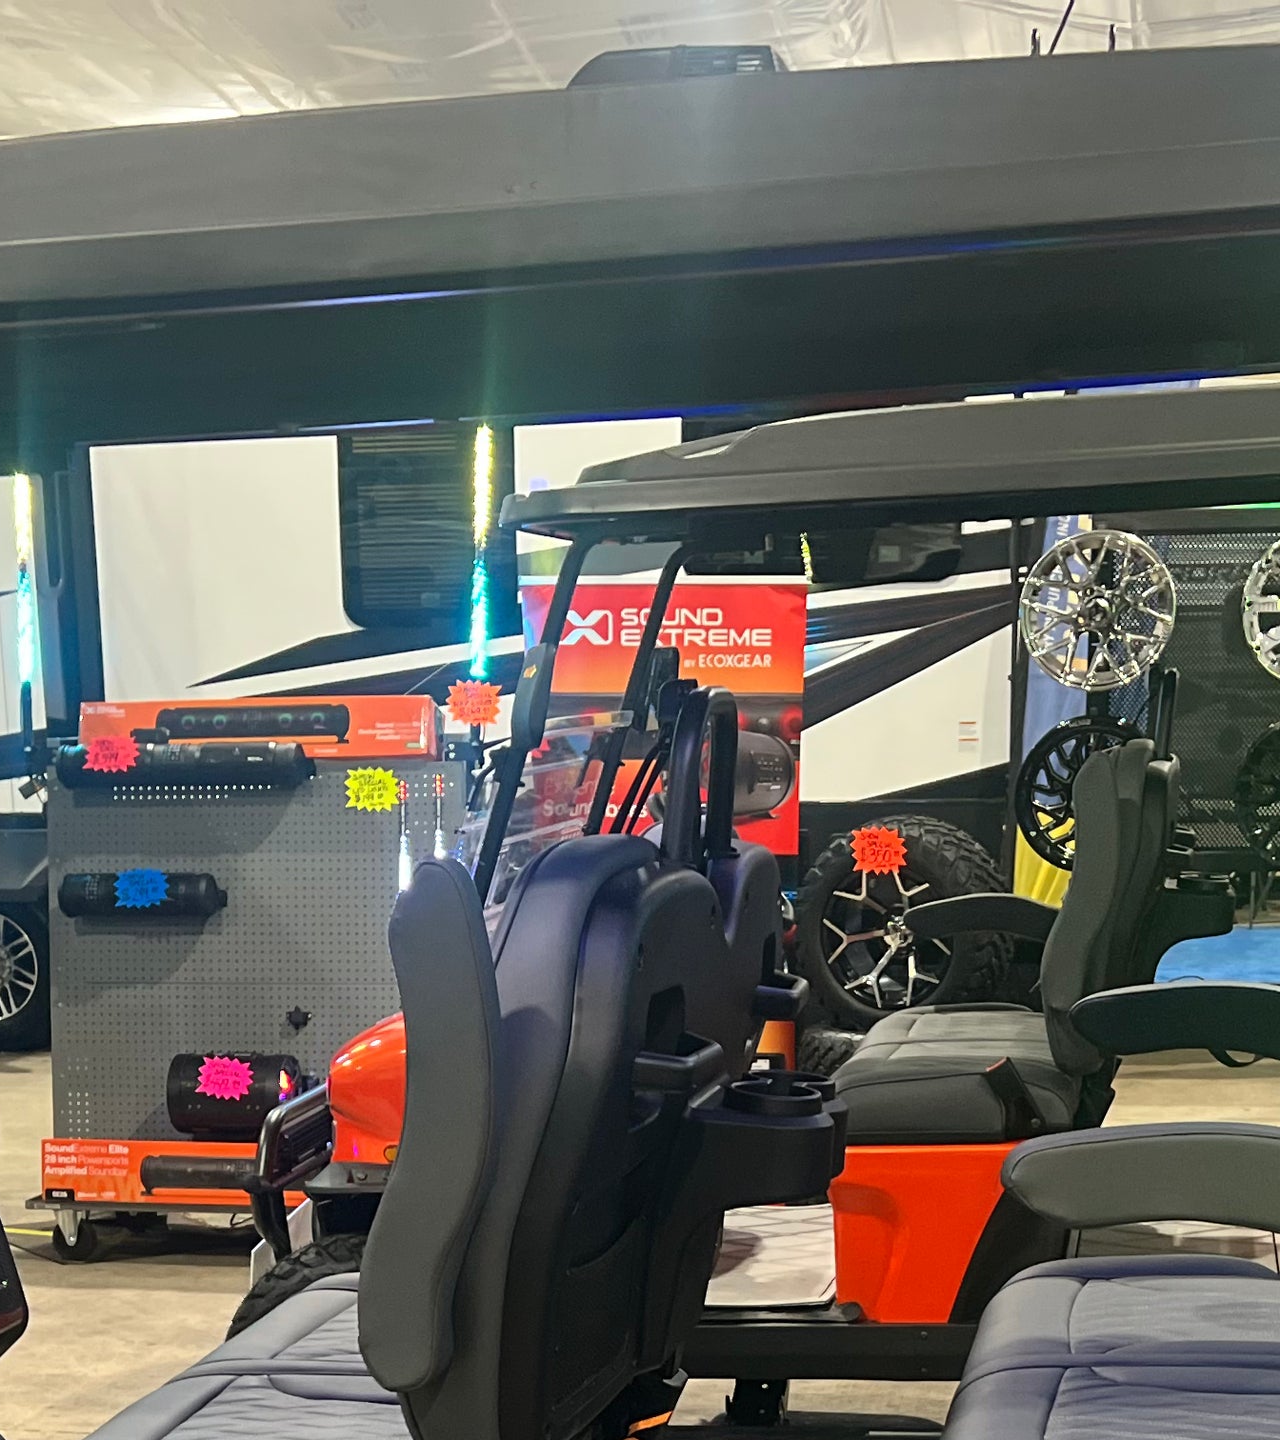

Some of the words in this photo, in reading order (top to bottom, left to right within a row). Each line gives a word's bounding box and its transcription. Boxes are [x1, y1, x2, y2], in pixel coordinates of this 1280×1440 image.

[620, 607, 723, 626] SOUND
[620, 628, 772, 647] EXTREME
[698, 653, 772, 668] ECOXGEAR
[58, 1154, 77, 1164] inch
[78, 1155, 129, 1167] Powersports
[44, 1165, 88, 1176] Amplified
[88, 1166, 129, 1176] Soundbar
